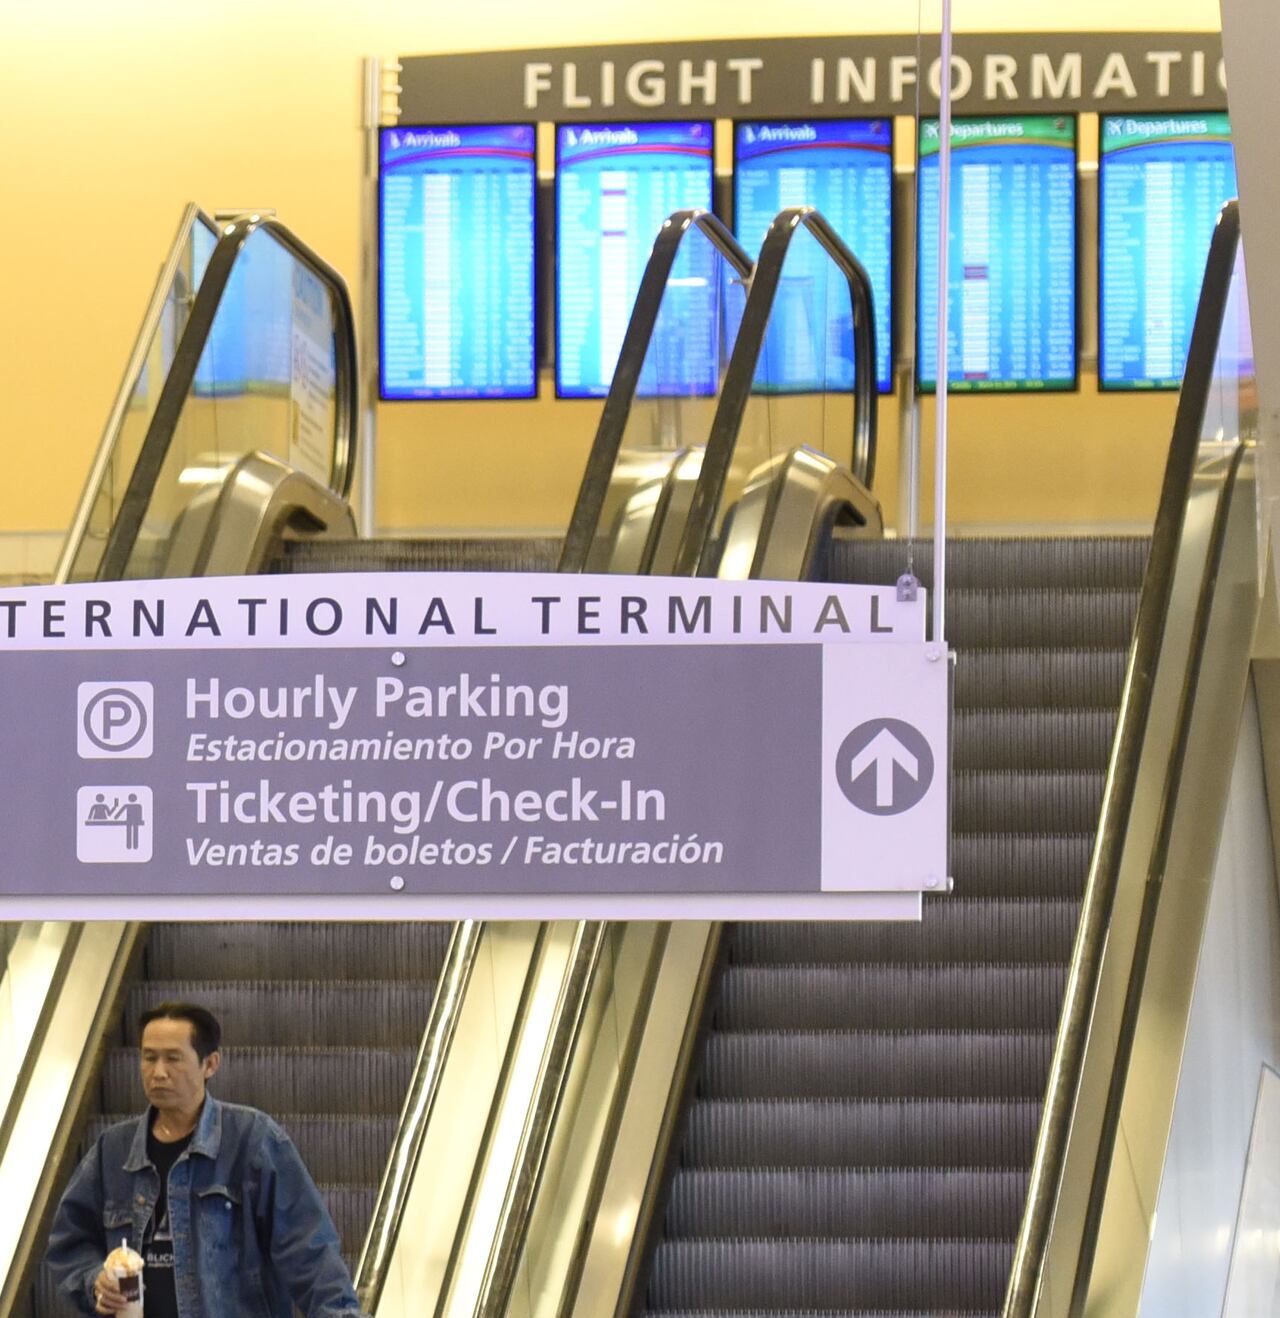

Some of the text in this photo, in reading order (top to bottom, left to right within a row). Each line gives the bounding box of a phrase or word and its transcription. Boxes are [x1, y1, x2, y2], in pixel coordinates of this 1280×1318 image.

[523, 51, 1228, 108] FLIGHT INFORMATI
[403, 131, 461, 148] Arrivals
[580, 128, 638, 146] Arrivals
[760, 125, 817, 142] Arrivals
[1126, 118, 1208, 137] Departures
[531, 594, 894, 635] TERMINAL
[185, 674, 569, 729] Hourly Parking
[186, 731, 636, 762] Estacionamiento Por Hora
[186, 778, 667, 834] Ticketing/Check-In
[185, 836, 298, 866] Ventas
[310, 836, 352, 866] de
[363, 836, 493, 866] boletos
[524, 833, 724, 865] Facturación
